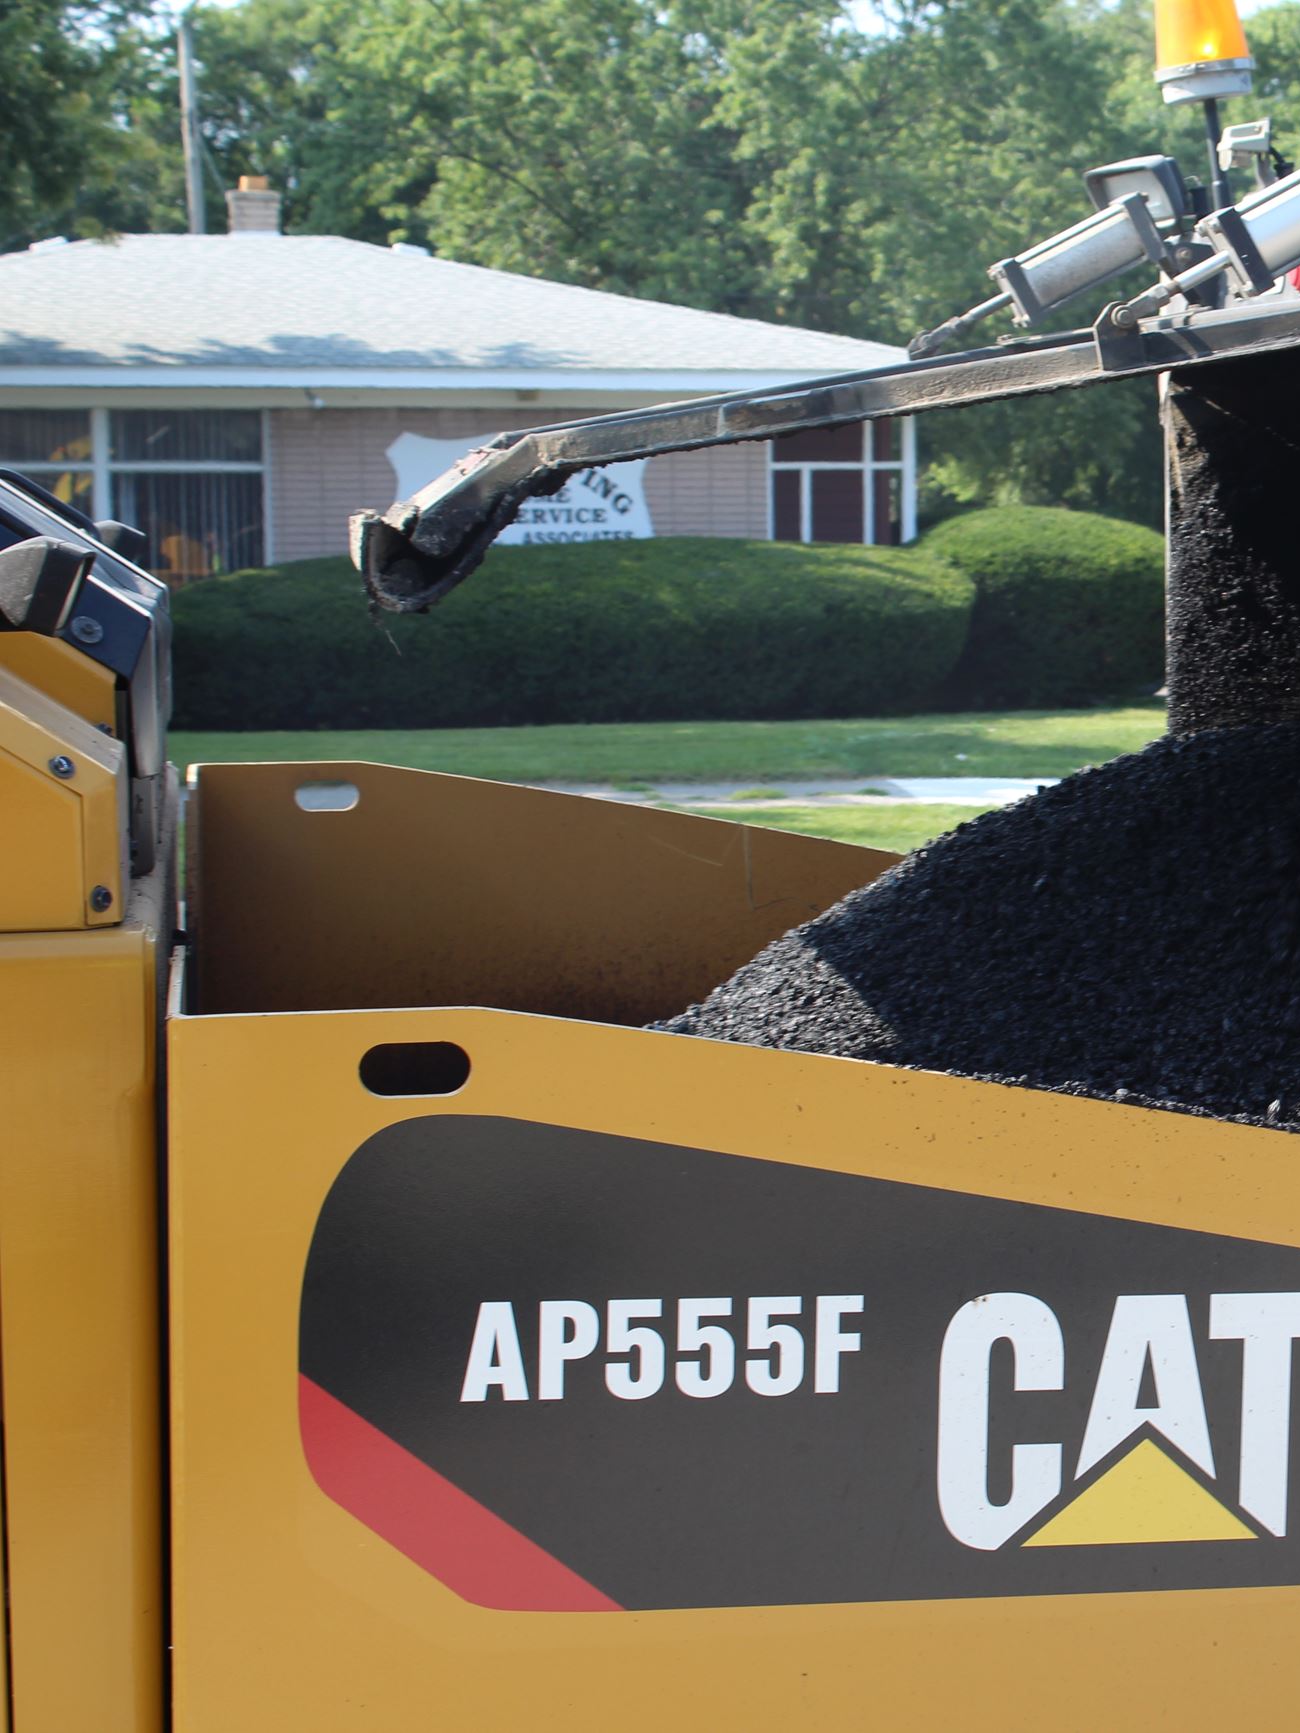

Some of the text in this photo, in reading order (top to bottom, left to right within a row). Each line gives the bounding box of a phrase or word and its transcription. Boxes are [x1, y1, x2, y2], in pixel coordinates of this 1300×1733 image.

[579, 467, 633, 515] ING
[514, 507, 608, 524] ERVICE
[460, 1294, 865, 1403] AP555F
